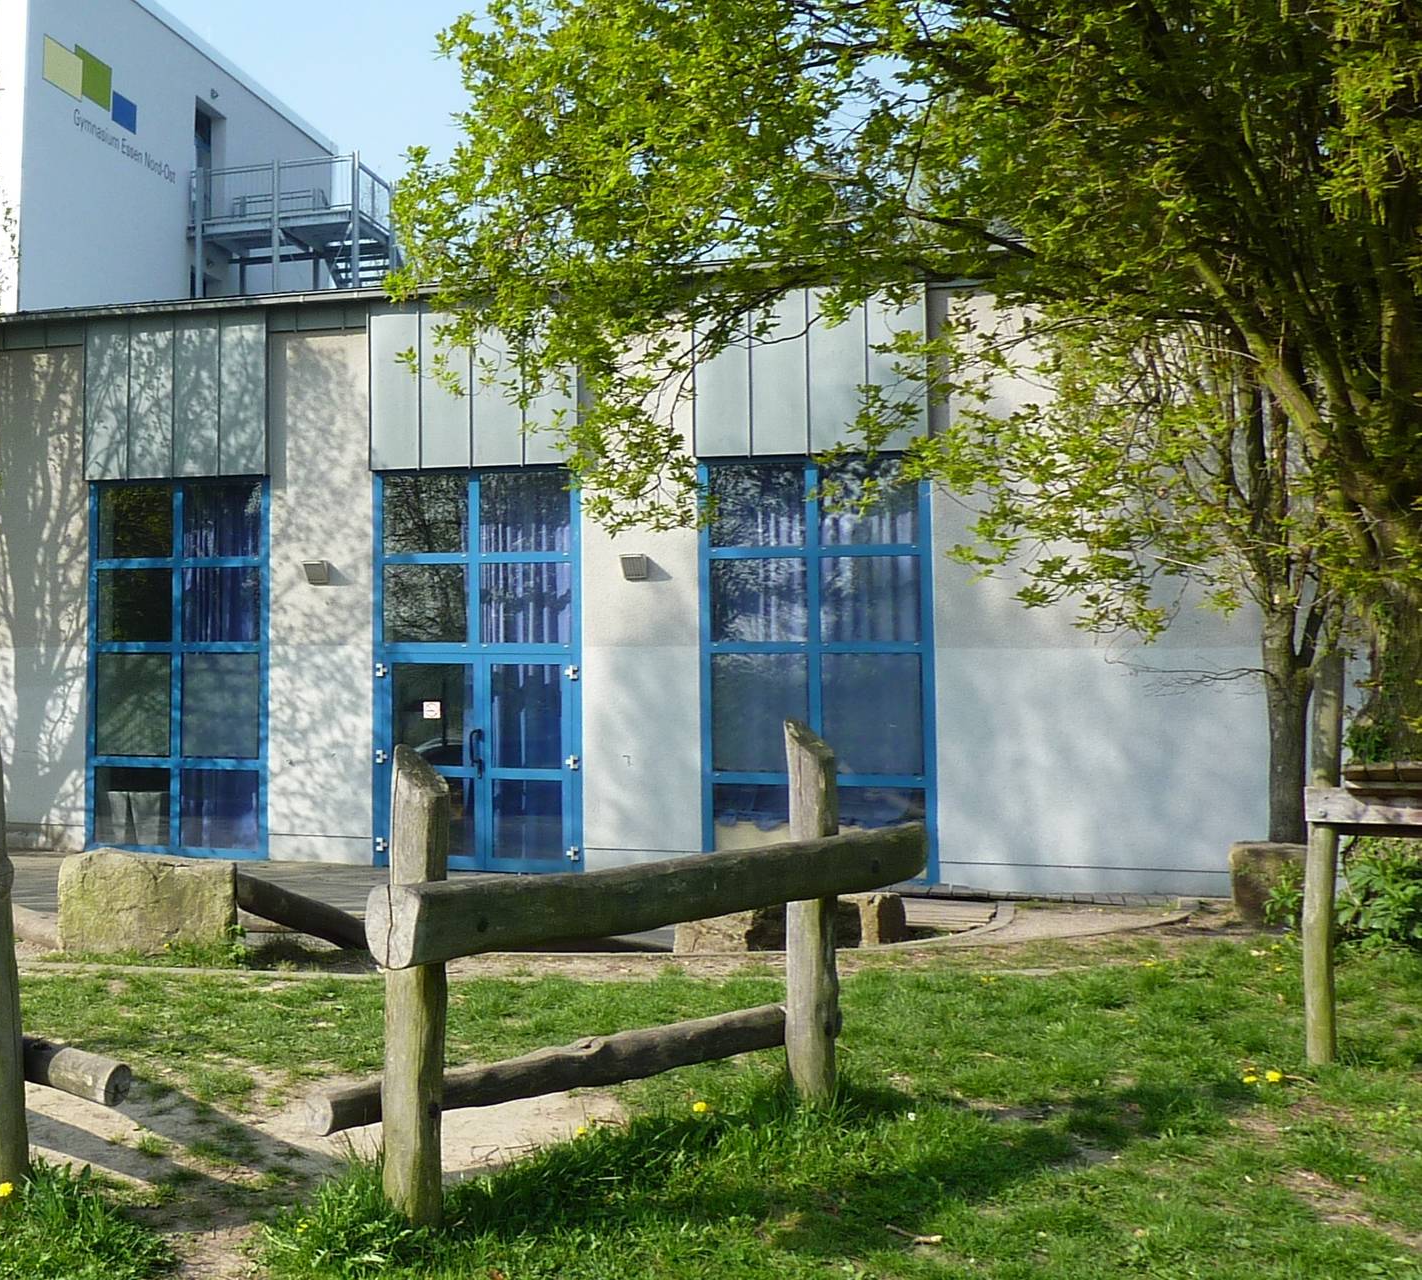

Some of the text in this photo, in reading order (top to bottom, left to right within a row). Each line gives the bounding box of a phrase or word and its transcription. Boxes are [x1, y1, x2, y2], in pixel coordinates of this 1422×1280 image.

[73, 108, 176, 185] Gymnasium Essen Nord-Ost
